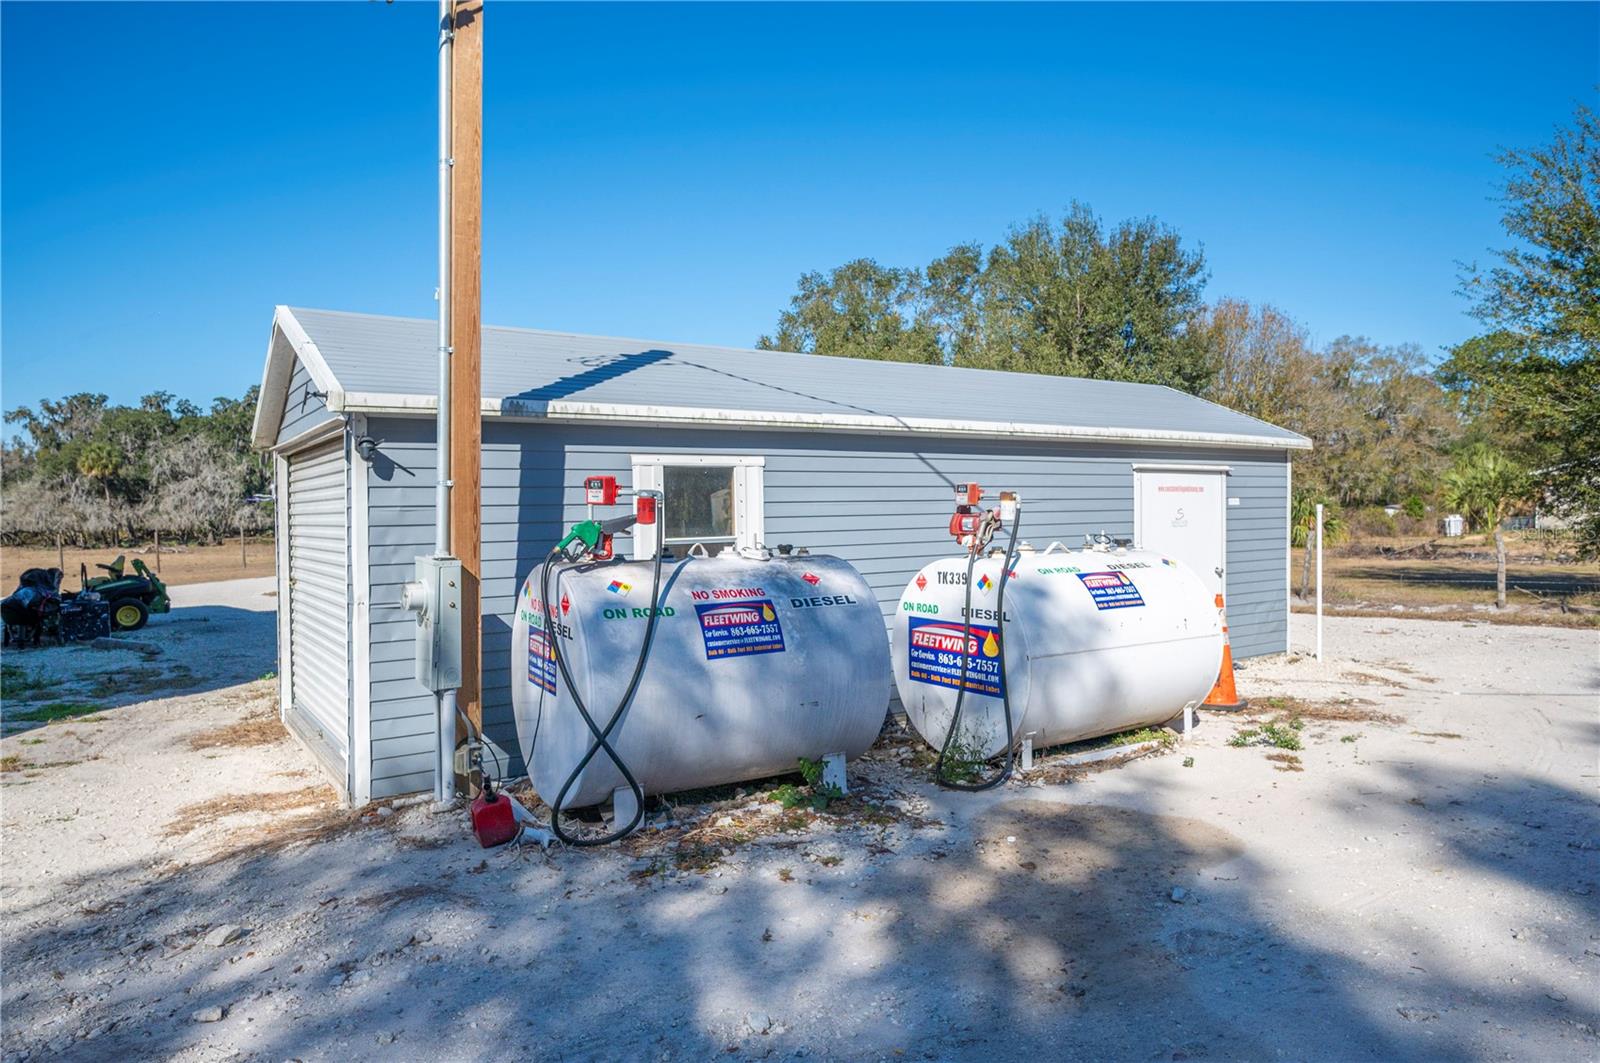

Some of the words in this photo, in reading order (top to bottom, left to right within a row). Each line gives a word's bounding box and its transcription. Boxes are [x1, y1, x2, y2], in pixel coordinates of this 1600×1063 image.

[1037, 567, 1053, 575] ON
[1106, 562, 1151, 570] DIESEL
[937, 571, 968, 585] TK339
[691, 590, 709, 600] NO
[711, 587, 766, 599] SMOKING
[790, 595, 857, 608] DIESEL
[903, 602, 914, 611] ON
[916, 602, 939, 614] ROAD
[603, 608, 627, 620] ON
[632, 606, 676, 618] ROAD
[704, 612, 760, 626] FLEETWING
[730, 624, 779, 637] 863-665-7557
[912, 632, 978, 654] FLEETWING
[937, 652, 999, 674] 863-65-7557
